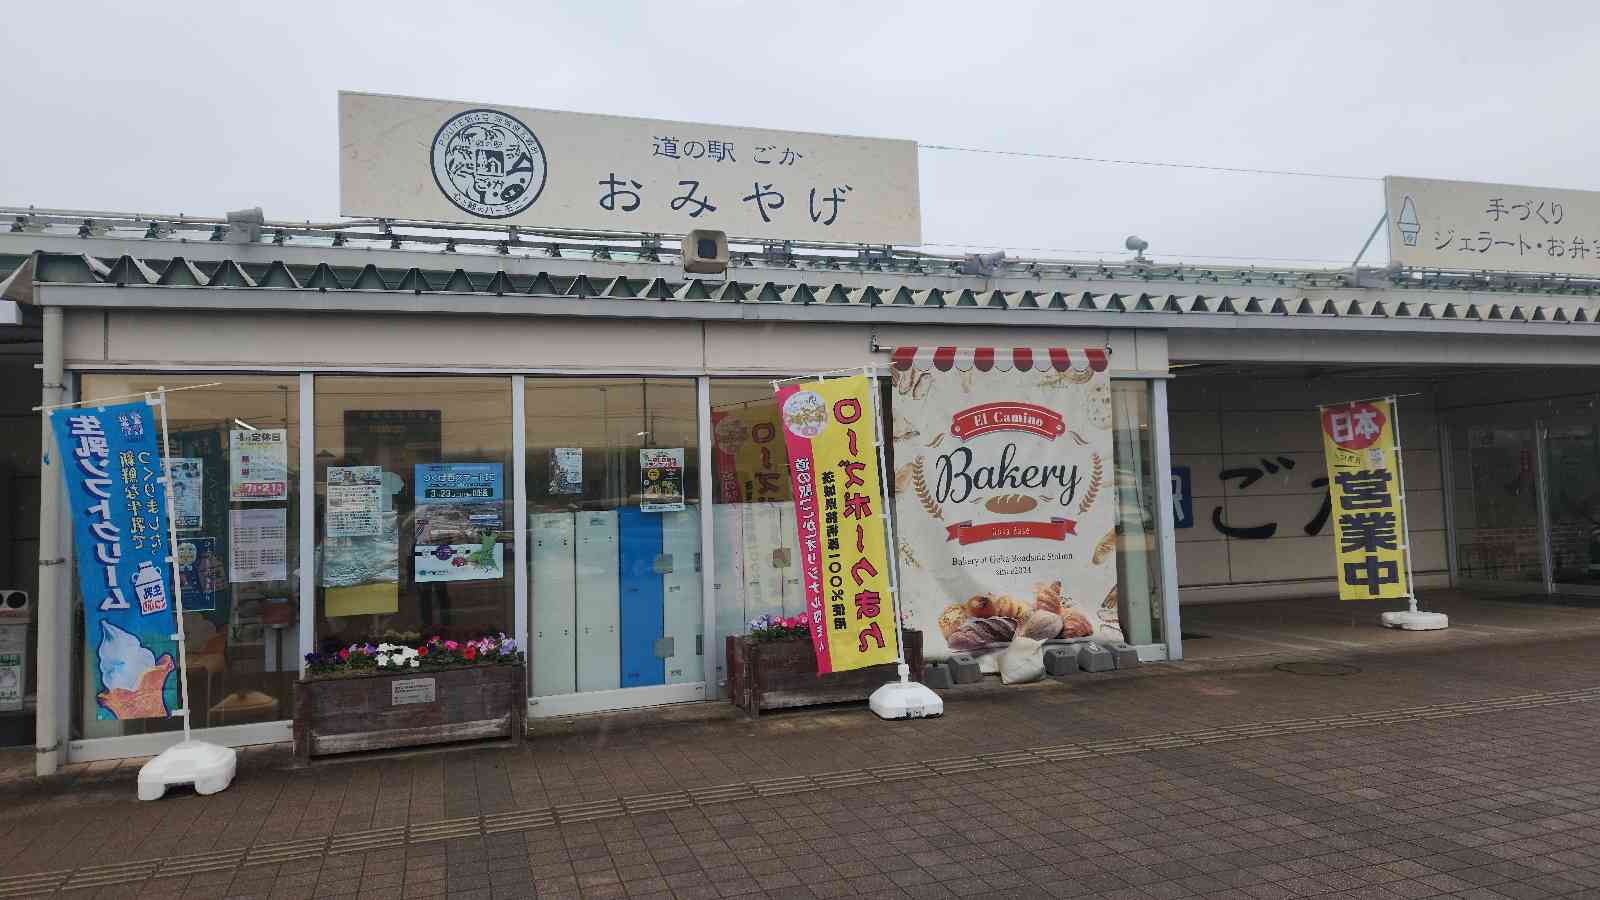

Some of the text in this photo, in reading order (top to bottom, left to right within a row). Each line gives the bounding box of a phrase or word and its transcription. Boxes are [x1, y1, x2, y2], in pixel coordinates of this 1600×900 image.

[652, 135, 804, 167] 道の駅 ごか
[598, 172, 854, 227] おみやげ
[1486, 198, 1564, 225] 手づくり
[974, 411, 1045, 428] El Camino
[936, 443, 1082, 506] Bakery
